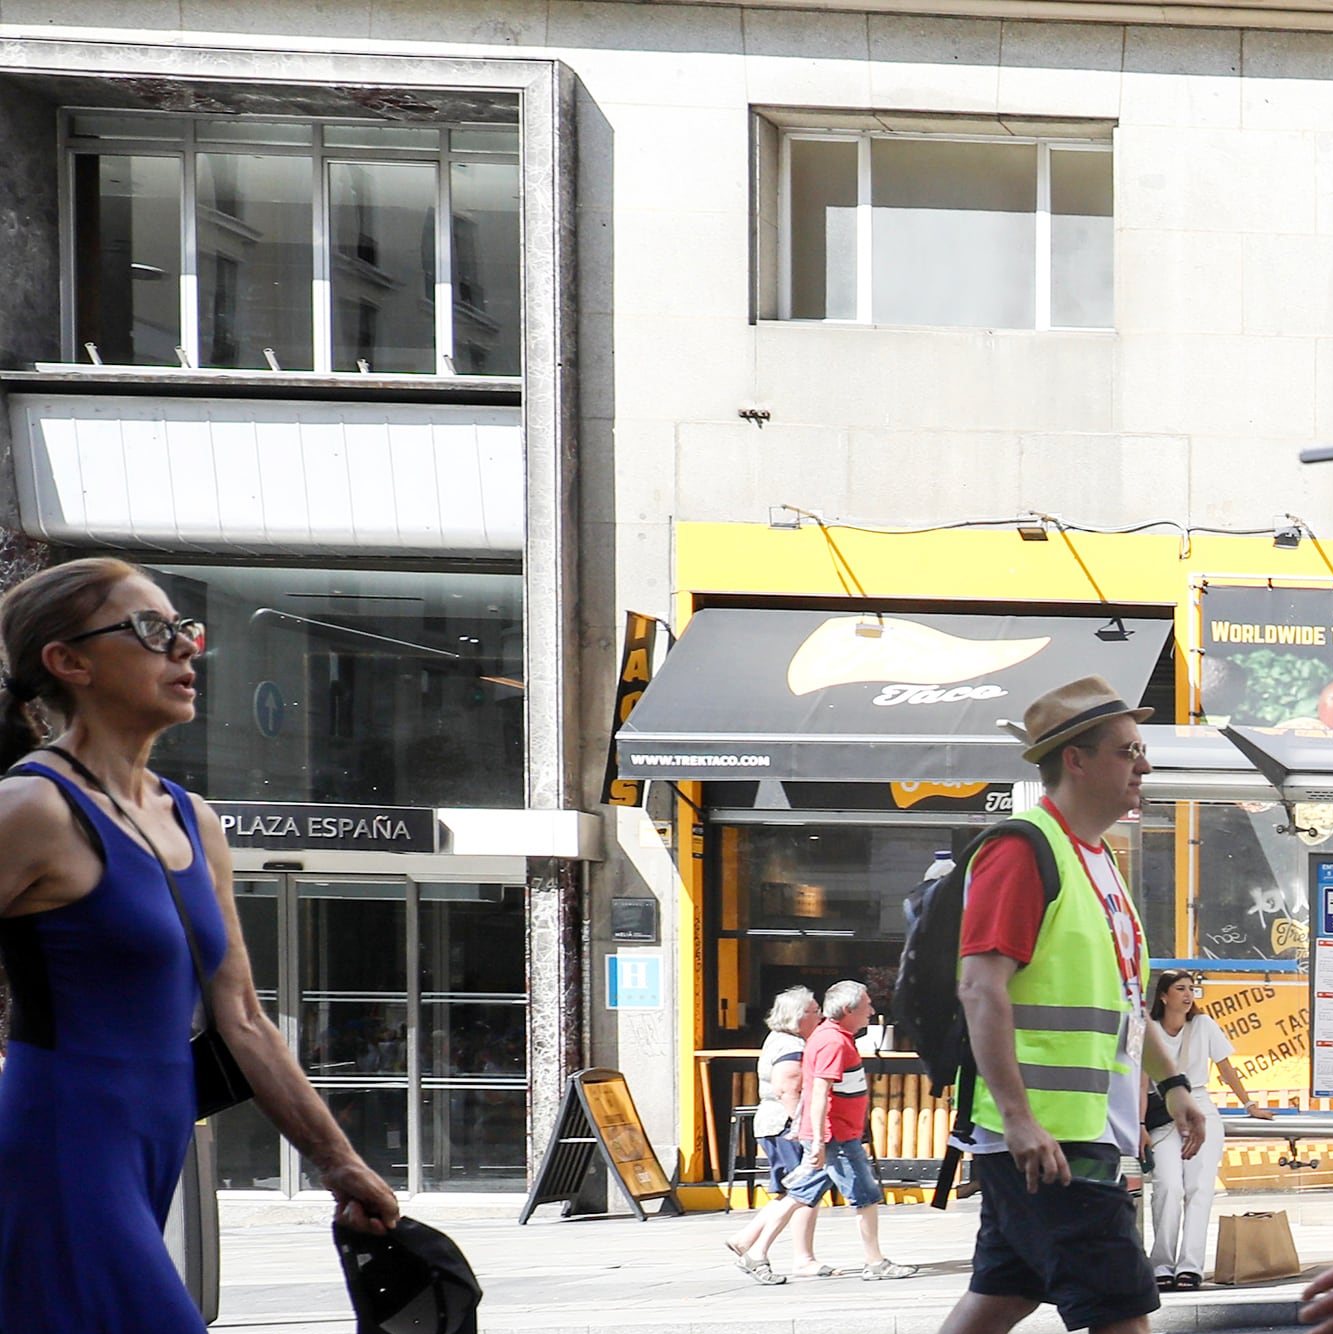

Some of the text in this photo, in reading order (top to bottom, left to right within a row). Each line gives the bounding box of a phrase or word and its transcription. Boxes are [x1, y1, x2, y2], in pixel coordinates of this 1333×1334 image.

[1210, 620, 1327, 646] WORLDWIDE
[872, 684, 1009, 706] Taco
[630, 754, 771, 767] WWW.TREKTACO.COM
[220, 814, 412, 840] PLAZA ESPAÑA
[1276, 921, 1309, 947] Tre
[621, 961, 649, 989] H
[1274, 1008, 1310, 1037] TAC
[1216, 1033, 1306, 1087] ARGARIT
